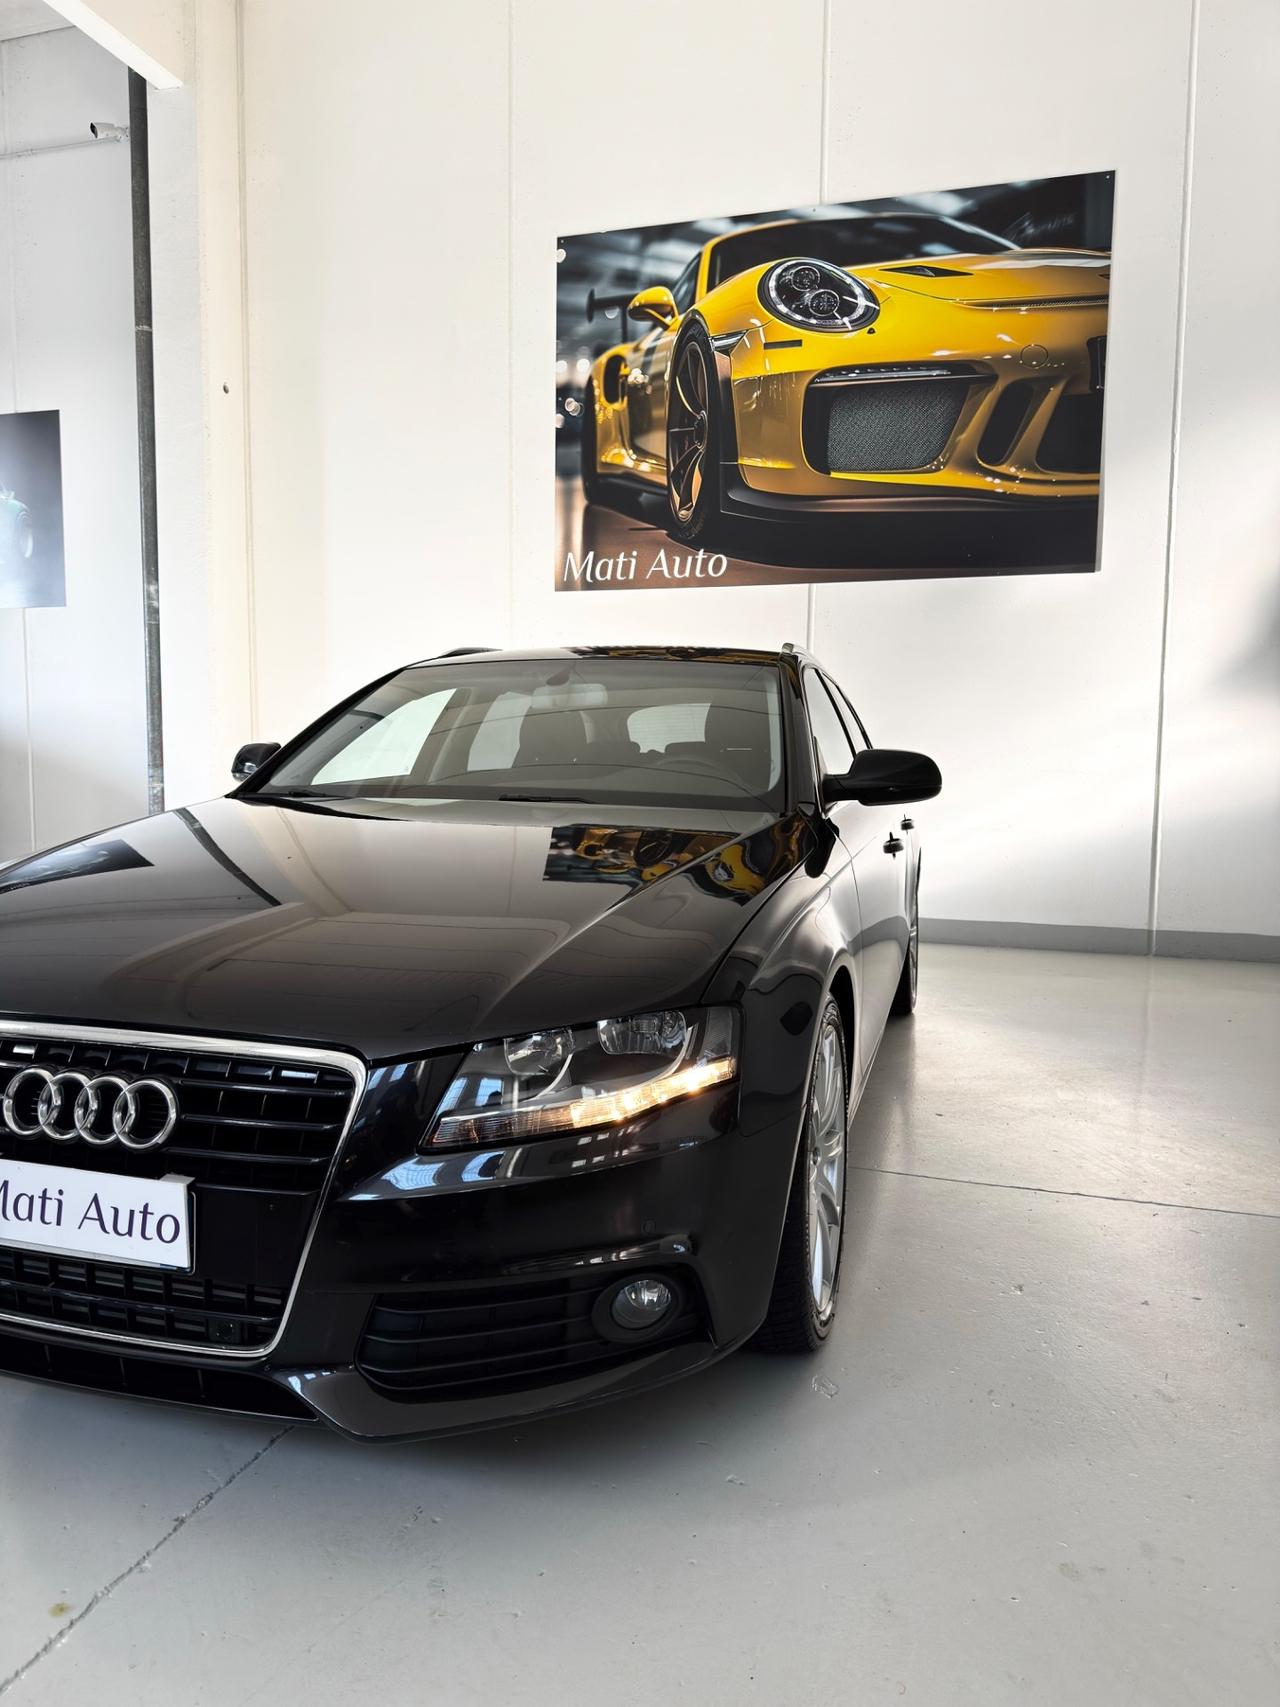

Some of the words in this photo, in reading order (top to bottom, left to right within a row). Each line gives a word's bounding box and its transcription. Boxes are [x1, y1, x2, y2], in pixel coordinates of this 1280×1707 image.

[564, 551, 637, 582] Mati
[646, 549, 727, 579] Auto
[78, 1193, 180, 1243] Auto
